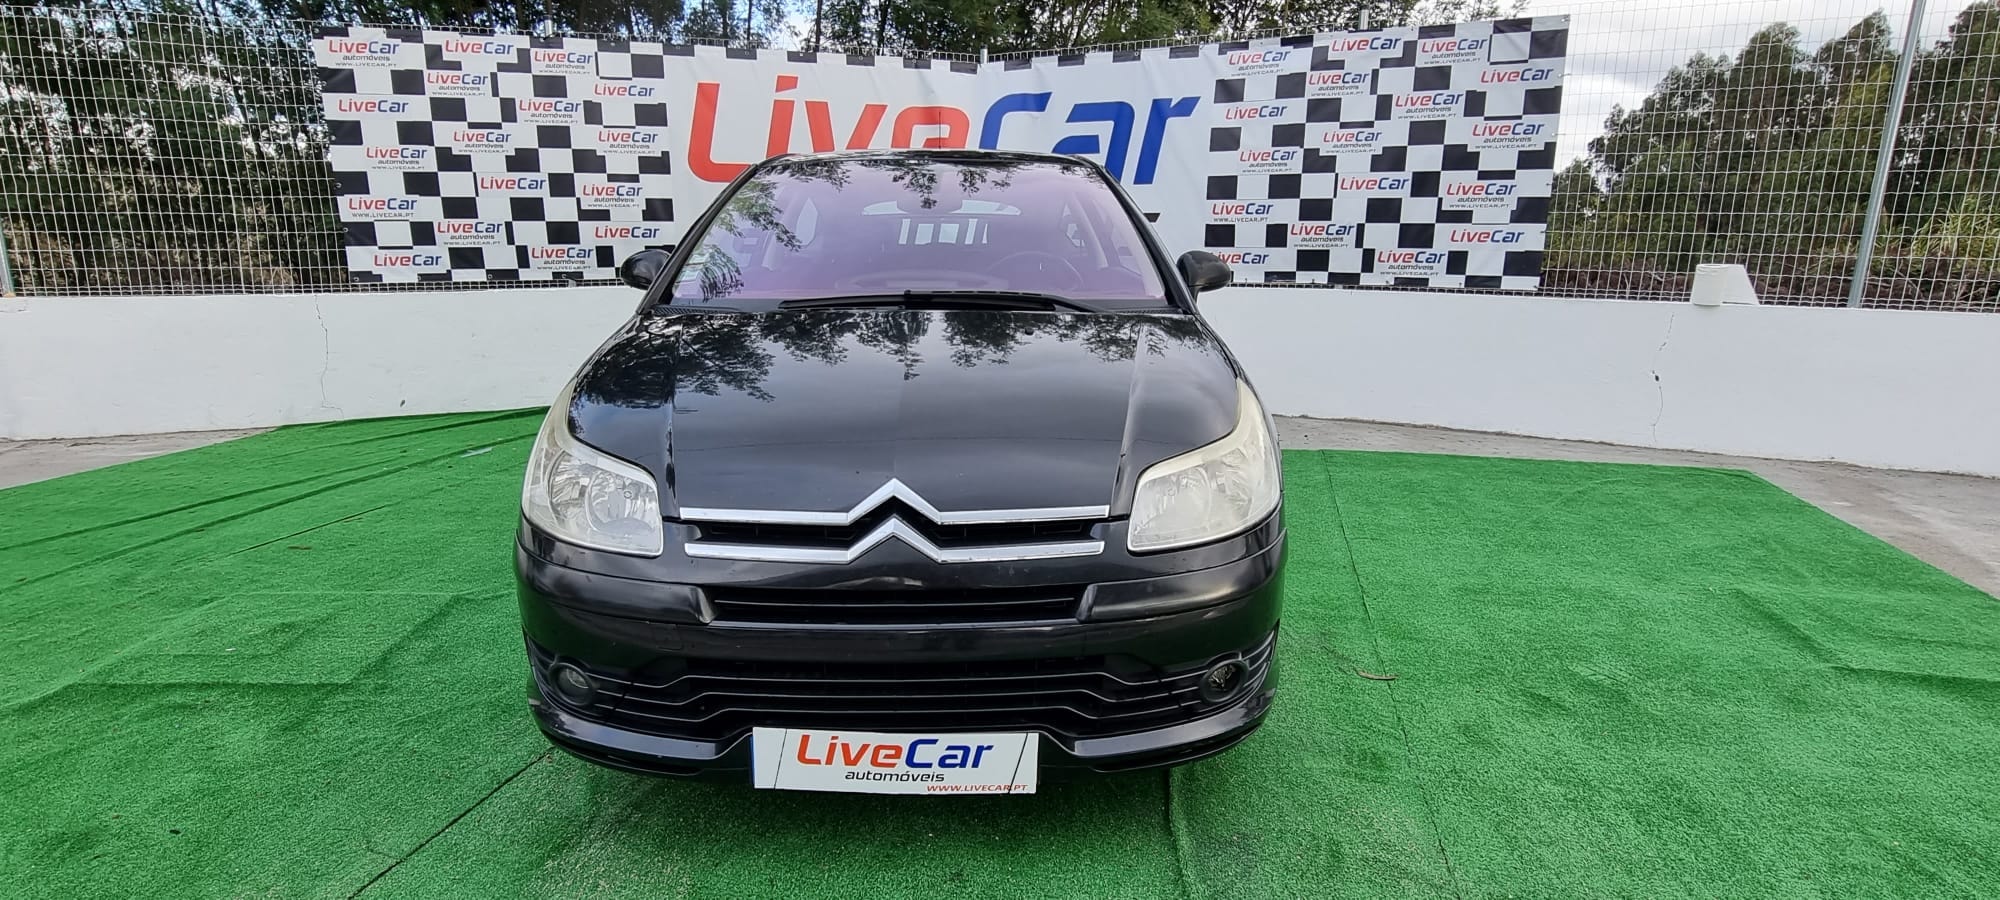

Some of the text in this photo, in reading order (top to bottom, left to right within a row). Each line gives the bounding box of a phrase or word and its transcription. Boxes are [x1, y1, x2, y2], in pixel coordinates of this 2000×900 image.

[329, 40, 399, 54] LiveCar
[445, 40, 514, 55] LiveCar
[1332, 37, 1400, 51] LiveCar
[1421, 38, 1488, 53] LiveCar
[342, 54, 390, 62] automóveis
[534, 50, 593, 64] LiveCar
[1229, 50, 1291, 66] LiveCar
[1431, 51, 1476, 59] automóveis
[545, 62, 585, 70] automóveis
[1238, 63, 1279, 71] automóveis
[427, 72, 488, 85] LiveCar
[1309, 72, 1369, 85] LiveCar
[1480, 68, 1553, 83] LiveCar
[594, 83, 654, 97] LiveCar
[338, 99, 408, 113] LiveCar
[519, 99, 581, 112] LiveCar
[1395, 92, 1463, 107] LiveCar
[1226, 105, 1287, 119] LiveCar
[1406, 106, 1452, 114] automóveis
[1472, 122, 1544, 136] LiveCar
[454, 131, 511, 143] LiveCar
[598, 130, 658, 143] LiveCar
[1323, 131, 1380, 143] LiveCar
[366, 147, 427, 159] LiveCar
[1240, 149, 1297, 162] LiveCar
[481, 176, 546, 190] LiveCar
[1340, 177, 1409, 190] LiveCar
[1446, 182, 1517, 196] LiveCar
[583, 184, 643, 196] LiveCar
[349, 197, 417, 210] LiveCar
[1212, 202, 1273, 215] LiveCar
[437, 221, 503, 233] LiveCar
[595, 225, 660, 238] LiveCar
[1291, 223, 1355, 235] LiveCar
[1450, 229, 1524, 243] LiveCar
[532, 246, 593, 259] LiveCar
[1377, 250, 1446, 263] LiveCar
[374, 254, 442, 266] LiveCar
[797, 734, 994, 768] LiveCar
[845, 770, 945, 782] automóveis
[926, 783, 1028, 792] WWW.LIVECAR.PT
